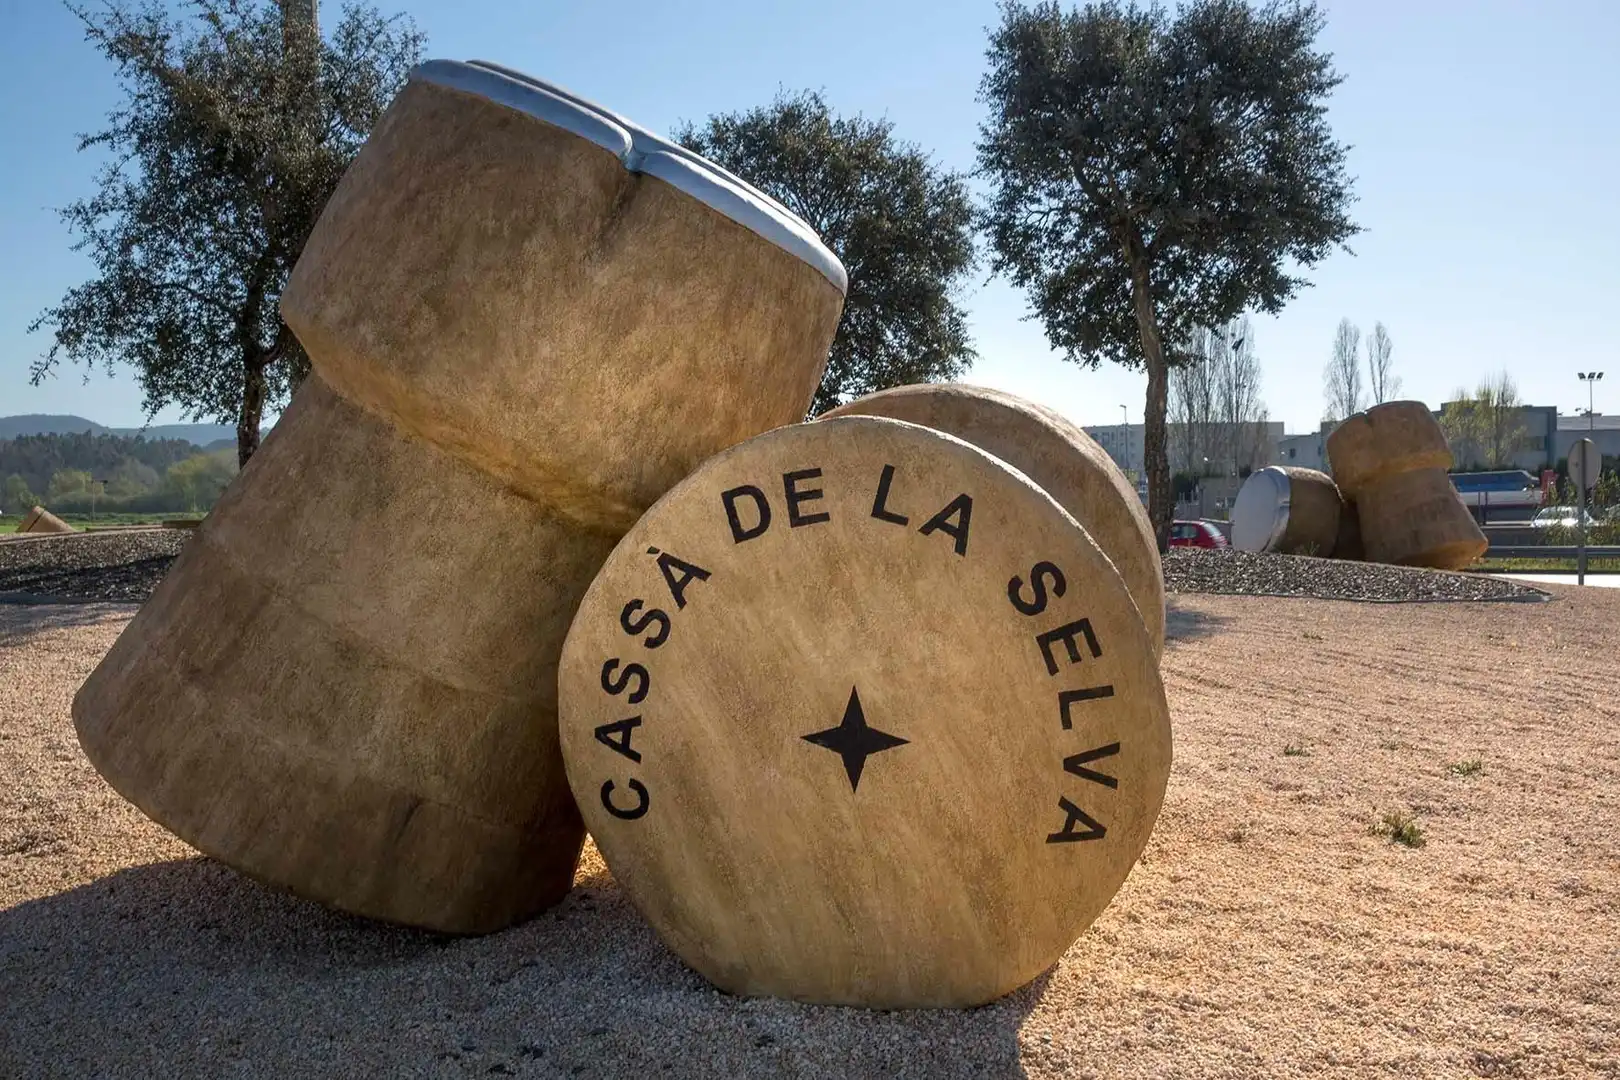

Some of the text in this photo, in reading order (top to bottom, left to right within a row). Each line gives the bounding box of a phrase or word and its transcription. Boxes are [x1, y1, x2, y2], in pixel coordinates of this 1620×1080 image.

[594, 464, 1121, 844] CASSÀ DE LA SELVA
